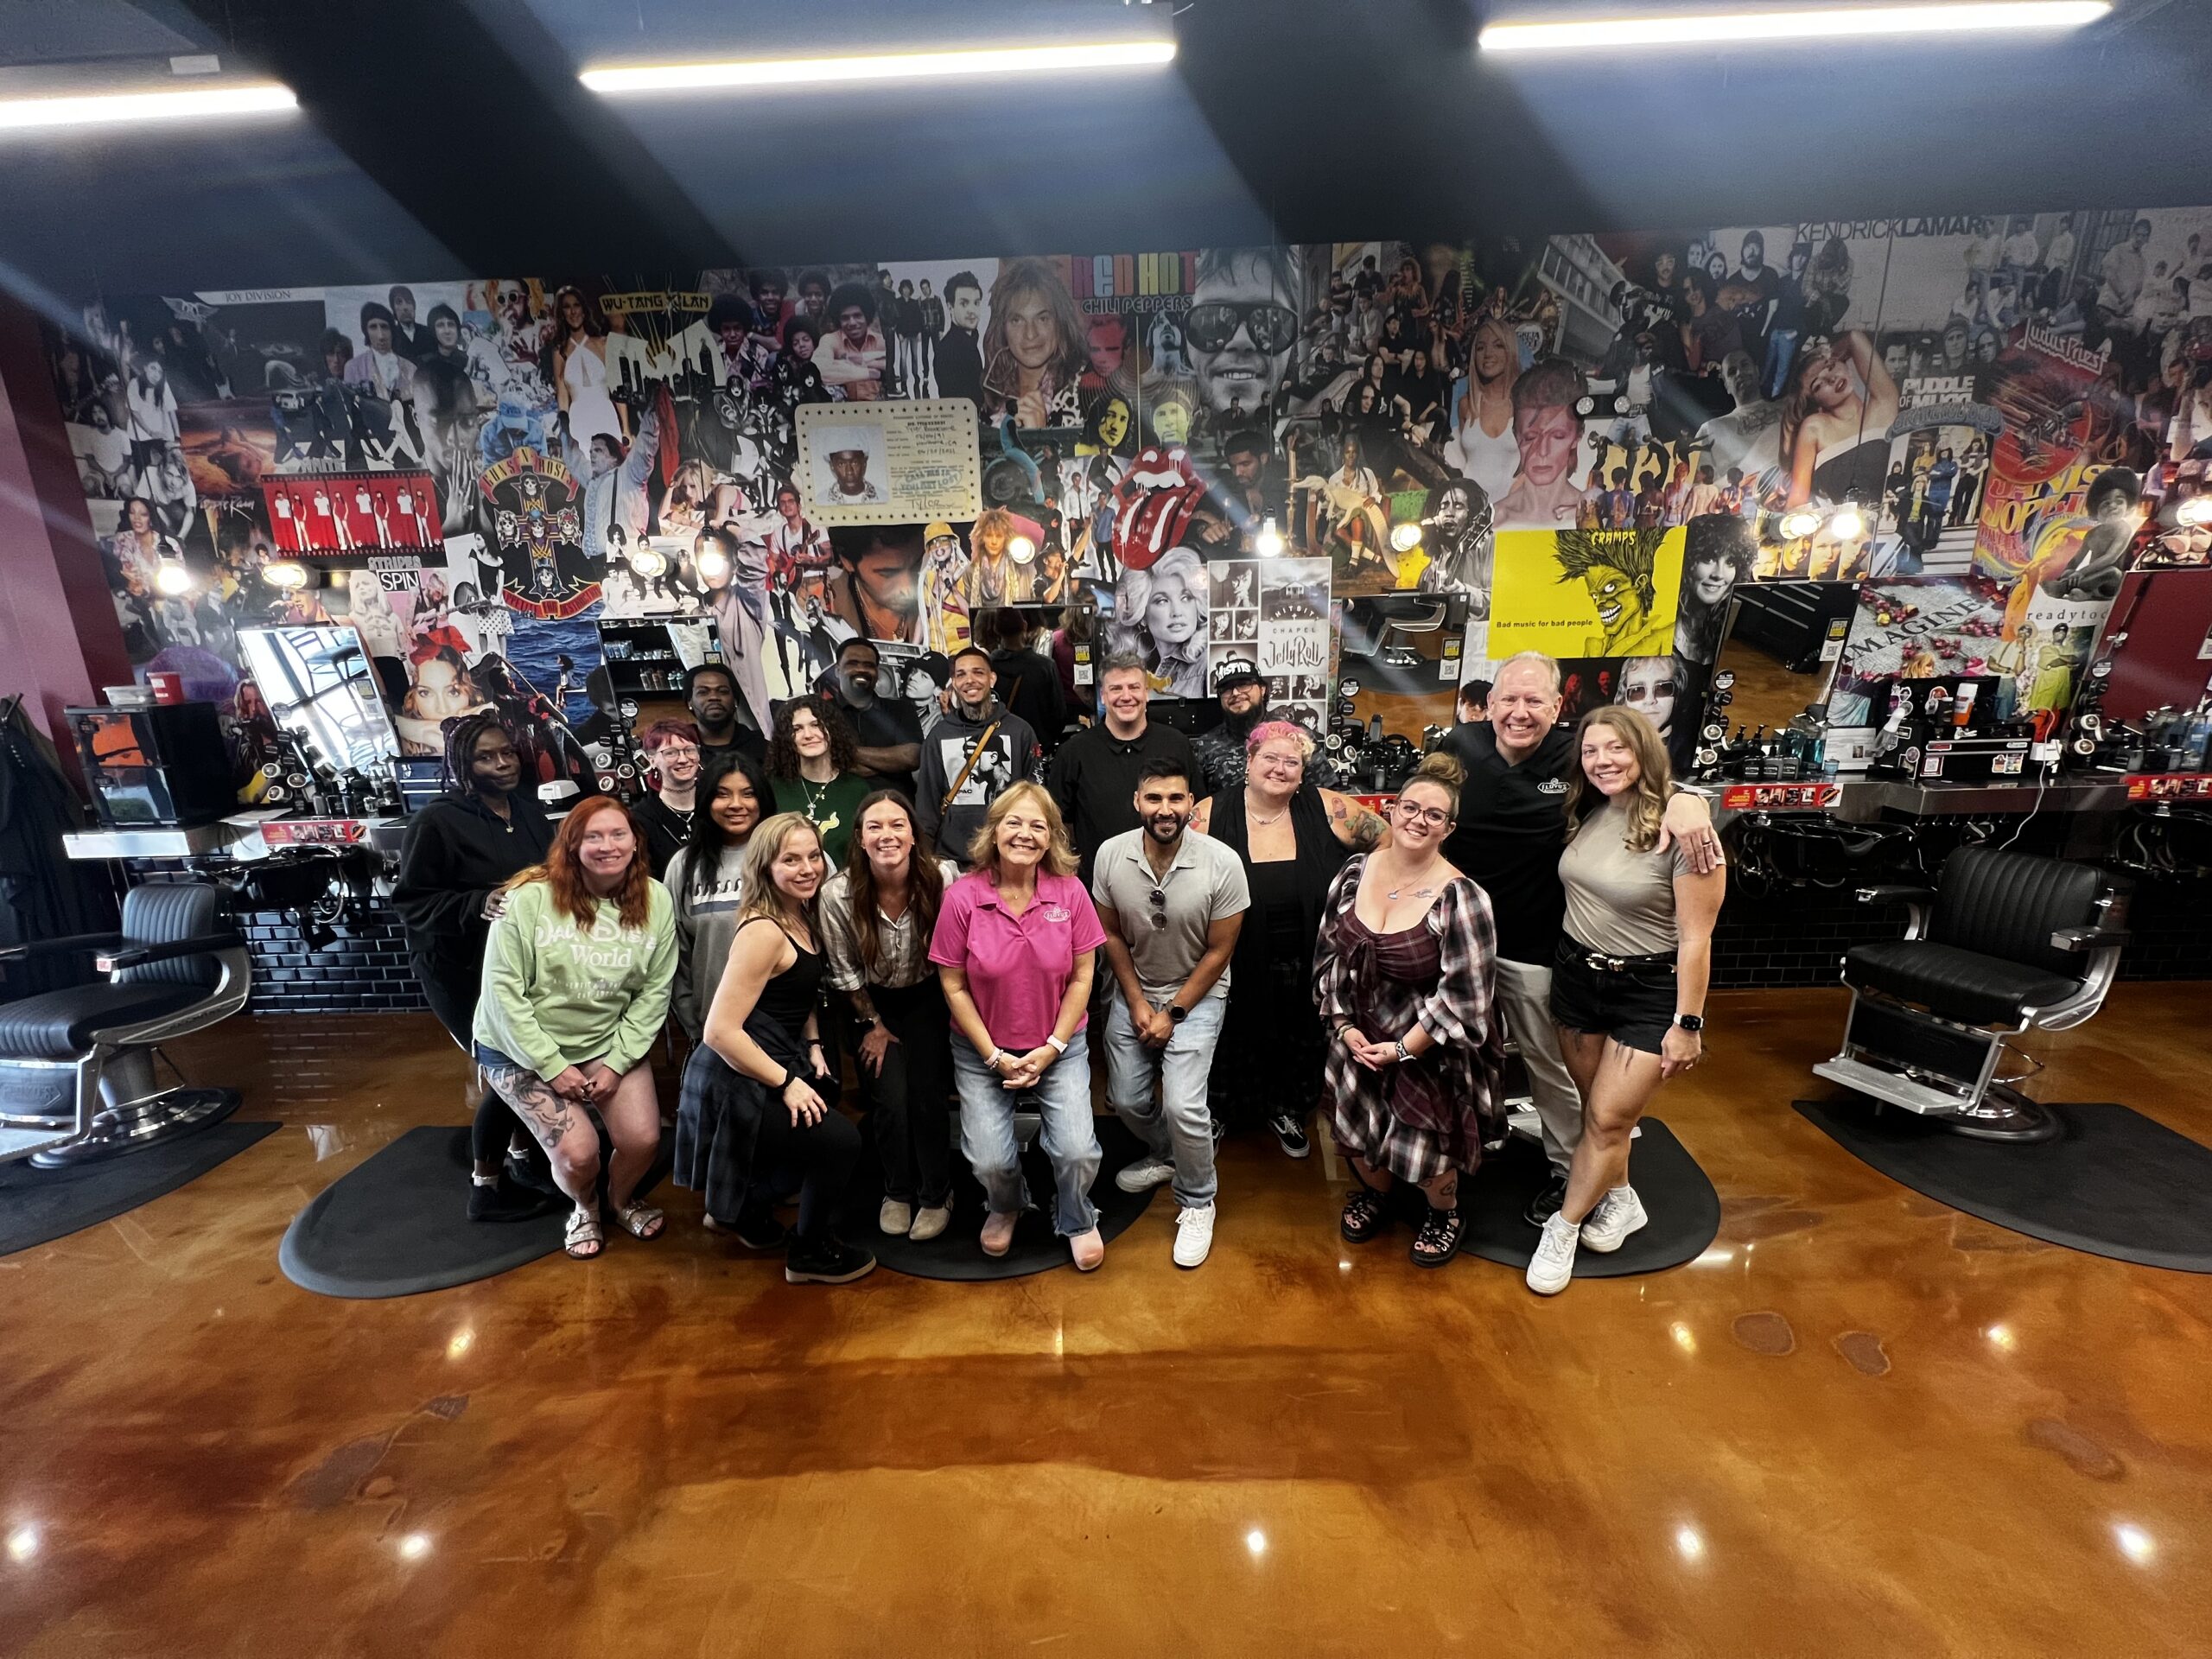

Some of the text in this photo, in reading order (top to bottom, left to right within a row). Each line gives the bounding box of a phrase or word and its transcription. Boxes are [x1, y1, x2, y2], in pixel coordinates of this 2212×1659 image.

[1071, 251, 1199, 299] RED HOT
[226, 289, 291, 303] JOY DIVISION
[1082, 295, 1194, 315] CHILI PEPPERS
[1902, 375, 1975, 396] PUDDLE
[1899, 395, 1912, 408] OF
[1590, 530, 1637, 546] CRAMPS
[367, 555, 423, 570] STRIPES
[380, 571, 421, 591] SPIN
[1567, 619, 1593, 628] people
[1262, 635, 1325, 669] Jelly Roll
[569, 944, 632, 969] World
